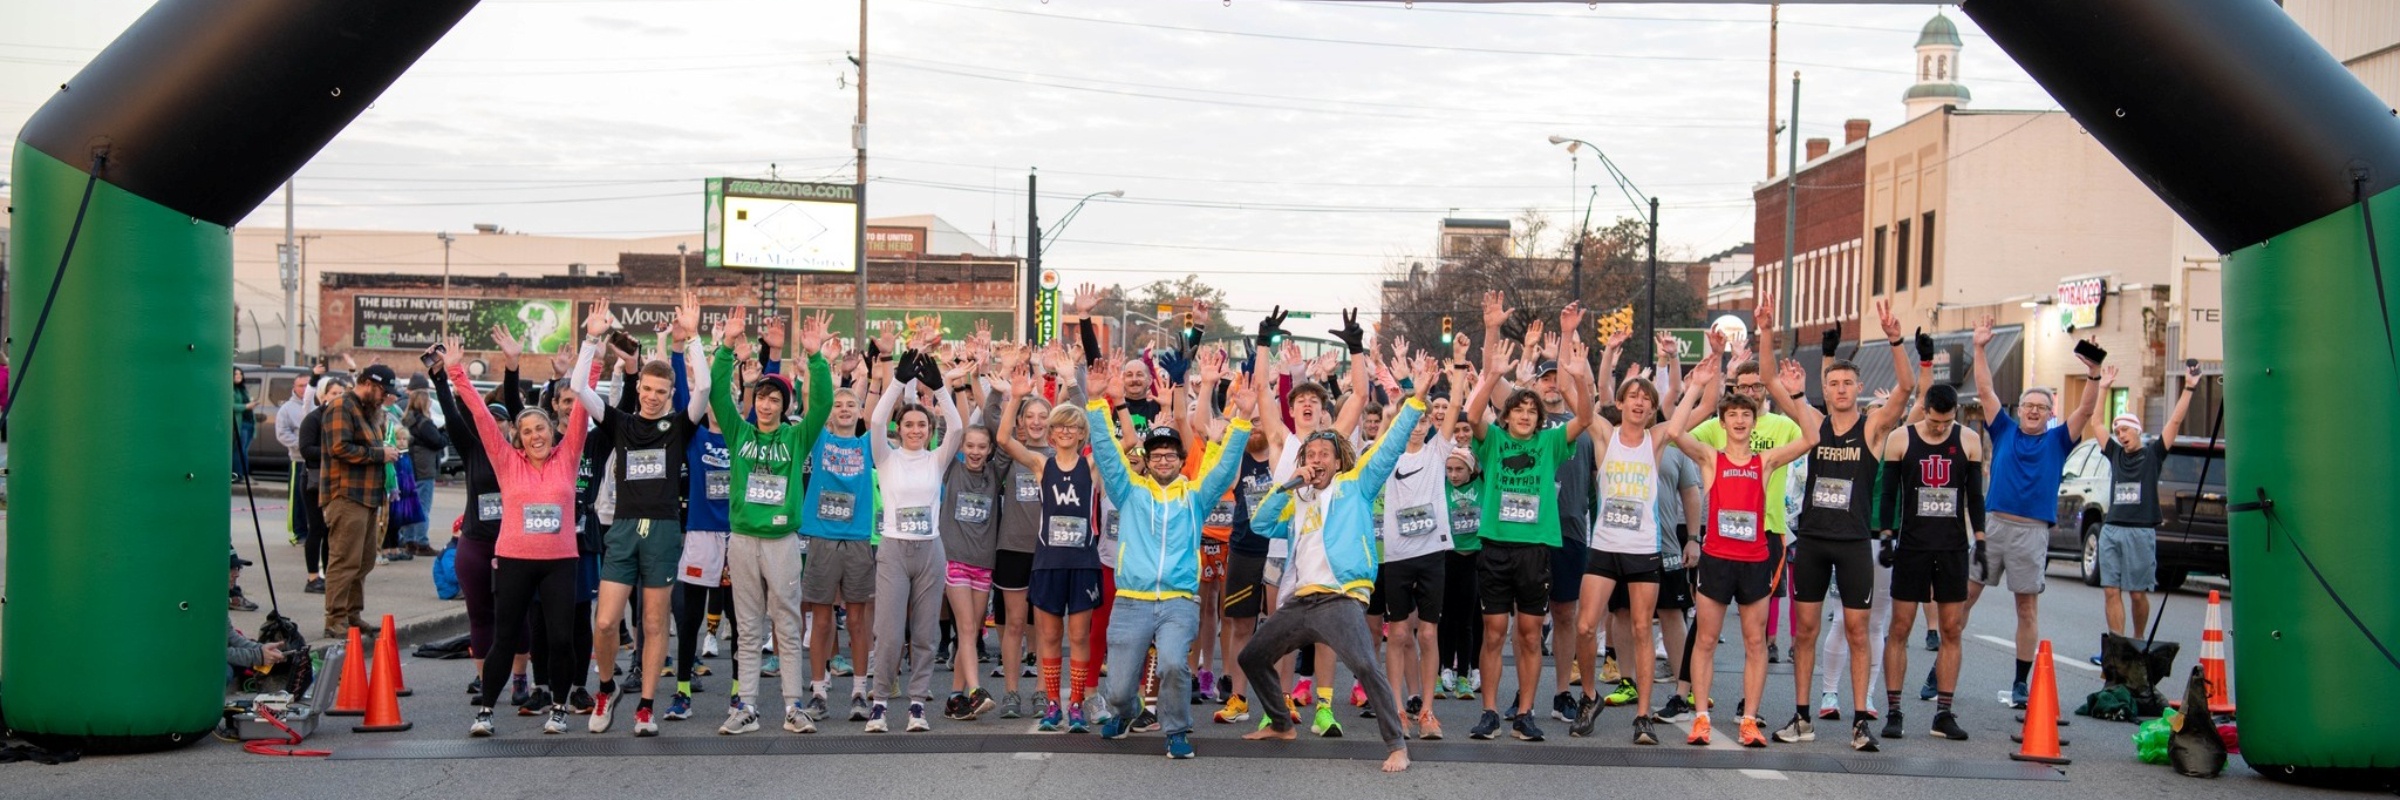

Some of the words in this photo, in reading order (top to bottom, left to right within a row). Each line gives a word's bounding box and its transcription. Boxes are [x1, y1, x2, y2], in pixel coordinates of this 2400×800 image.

[887, 233, 914, 242] UNITED
[868, 241, 886, 251] THE
[887, 242, 914, 251] HERD
[2058, 280, 2101, 305] TOBACCO
[359, 297, 380, 307] THE
[381, 298, 409, 308] BEST
[447, 300, 475, 310] REST
[363, 310, 377, 320] We
[379, 310, 397, 321] take
[398, 313, 417, 321] care
[418, 312, 430, 323] of
[448, 313, 471, 322] Herd
[1816, 445, 1862, 462] FERRUM
[629, 463, 663, 475] 5059
[1606, 461, 1652, 477] ENJOY
[1722, 468, 1759, 480] MIDLAND
[1606, 472, 1646, 486] YOUR
[748, 487, 783, 502] 5302
[1814, 491, 1847, 504] 5265
[820, 504, 851, 517] 5386
[960, 506, 988, 519] 5371
[1502, 506, 1535, 520] 5250
[1922, 501, 1953, 512] 5012
[525, 518, 560, 529] 5060
[1606, 511, 1638, 526] 5384
[900, 520, 929, 532] 5318
[1401, 518, 1434, 533] 5370
[1721, 523, 1754, 537] 5249
[1053, 530, 1083, 543] 5317
